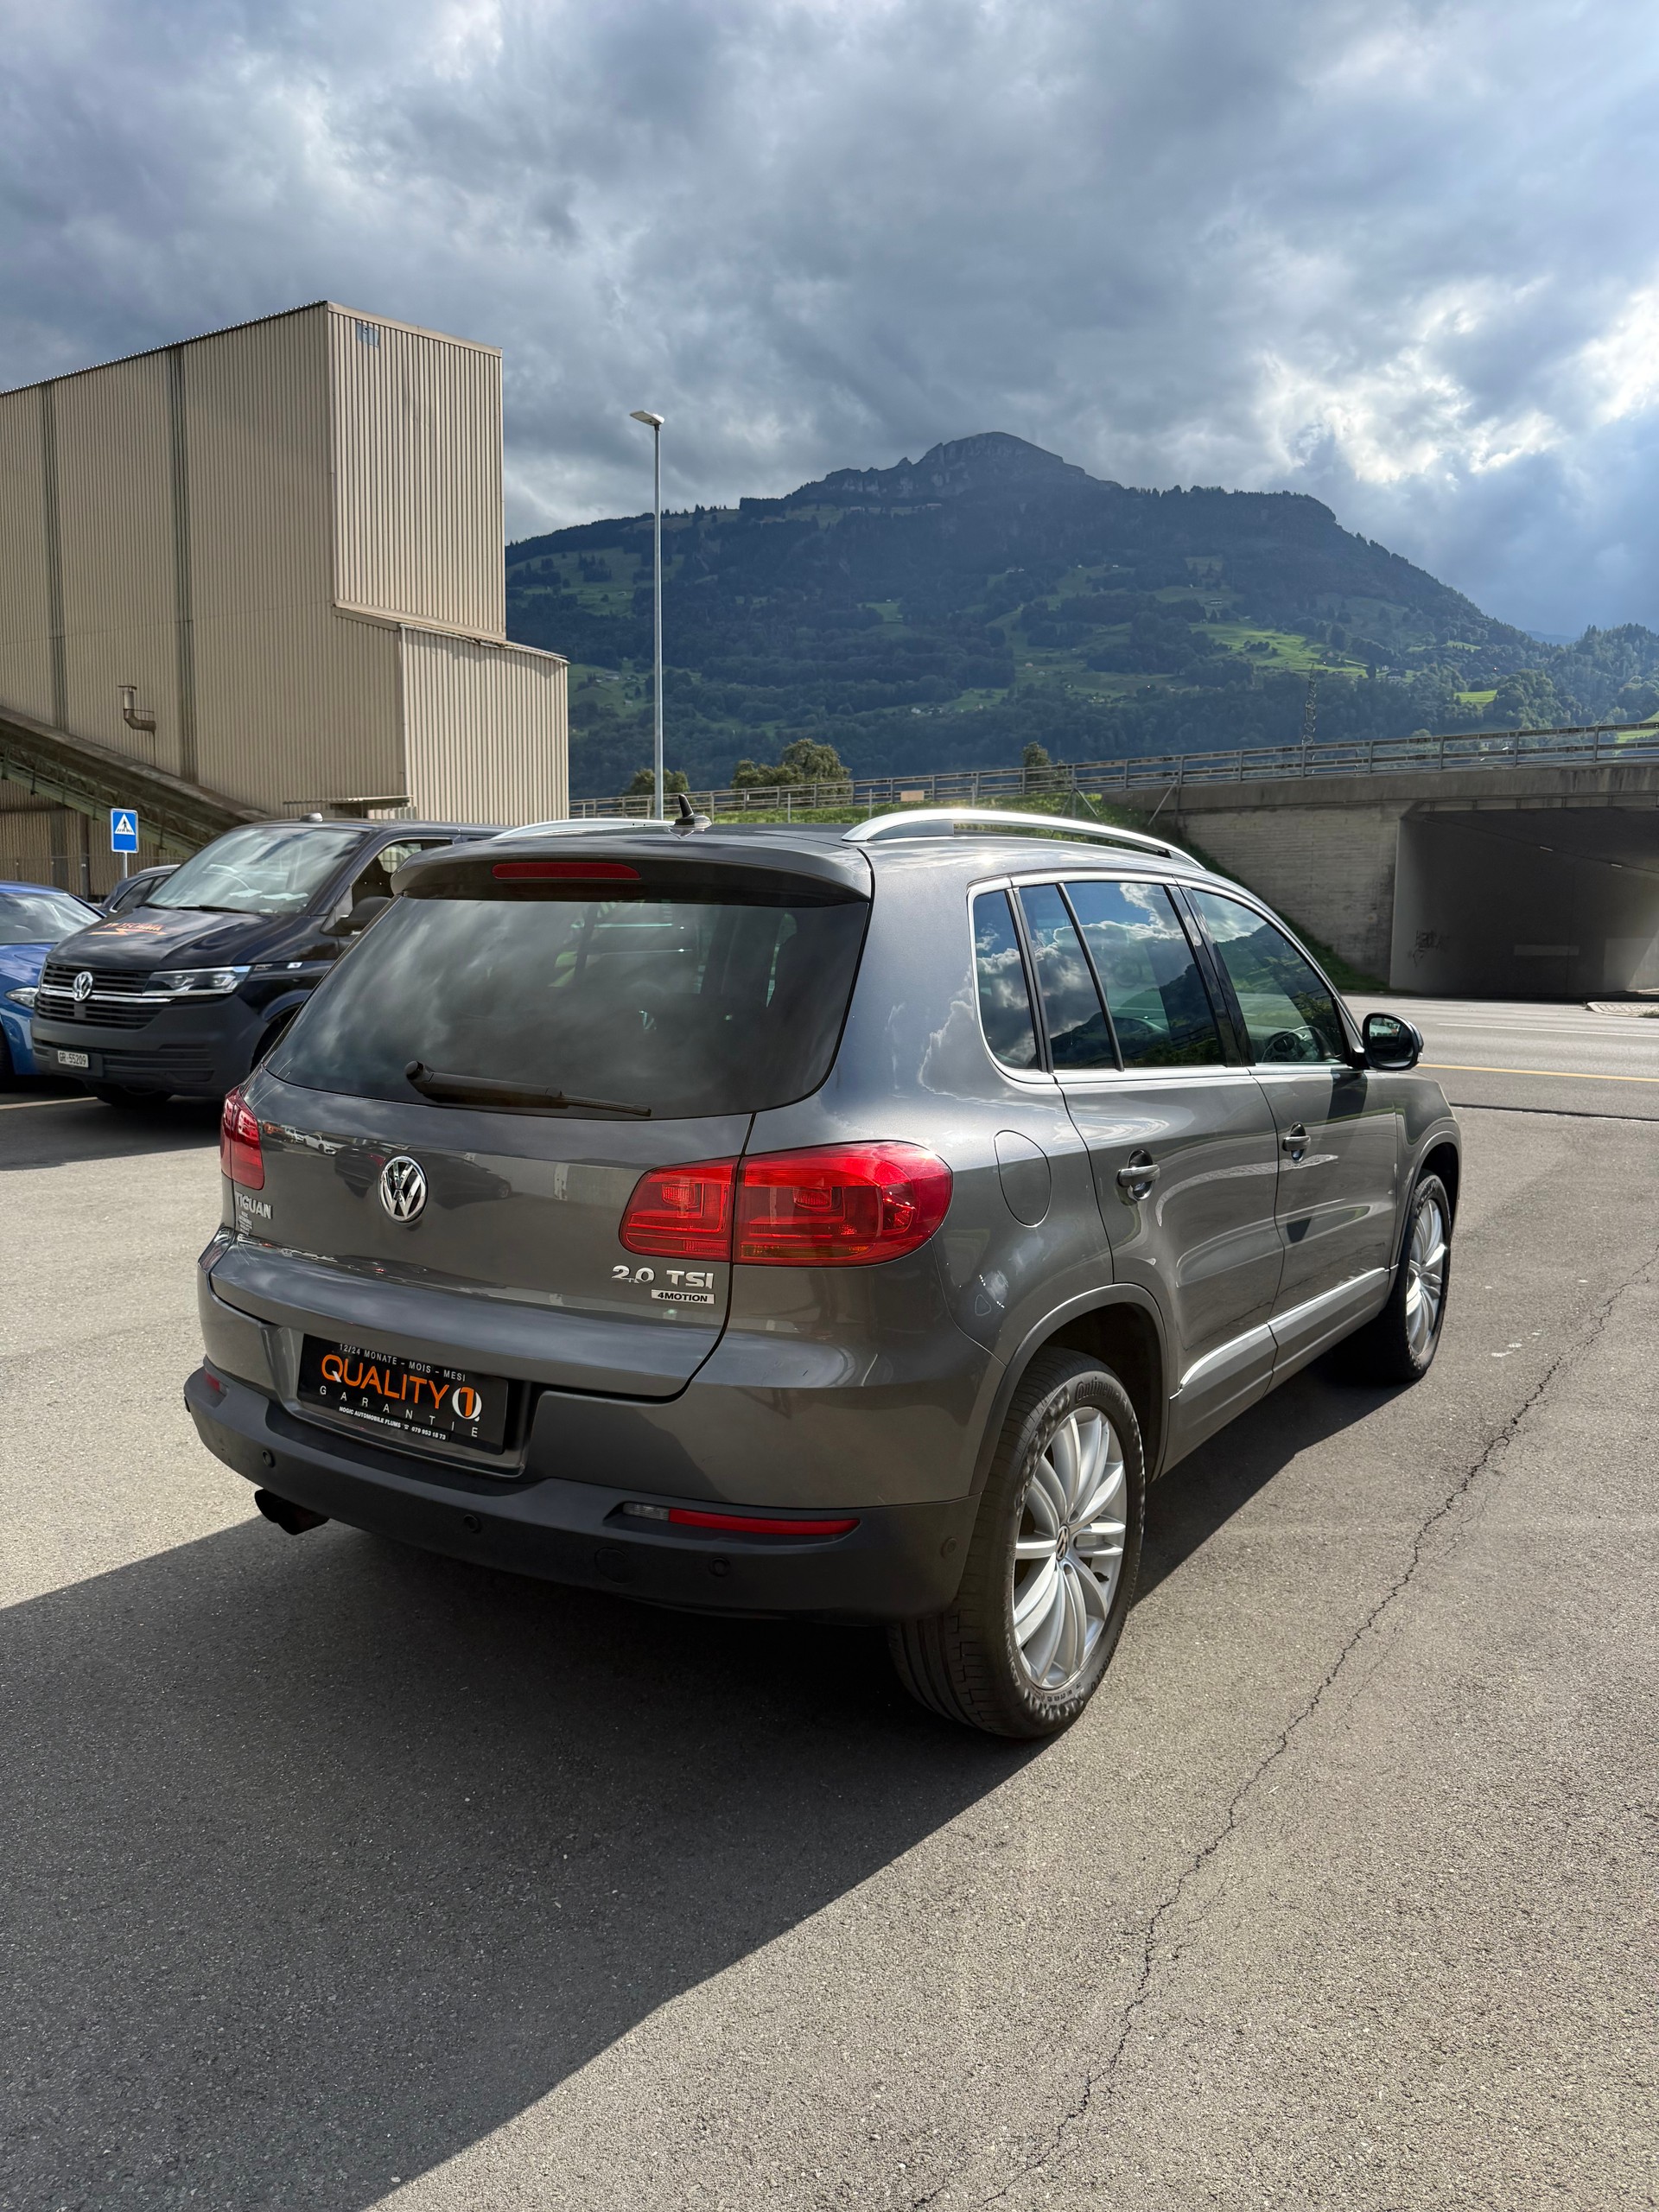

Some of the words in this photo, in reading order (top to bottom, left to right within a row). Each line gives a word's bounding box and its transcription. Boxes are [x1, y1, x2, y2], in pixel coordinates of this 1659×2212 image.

[235, 1191, 272, 1219] TIGUAN
[611, 1264, 655, 1284] 2.0
[666, 1269, 714, 1289] TSI
[657, 1291, 708, 1302] 4MOTION
[340, 1344, 360, 1355] 12/24
[364, 1349, 397, 1365] MONATE
[409, 1361, 431, 1374] MOIS
[443, 1369, 466, 1382] MESI
[321, 1354, 449, 1409] QUALITY
[353, 1410, 385, 1423] AUTOMOBILE
